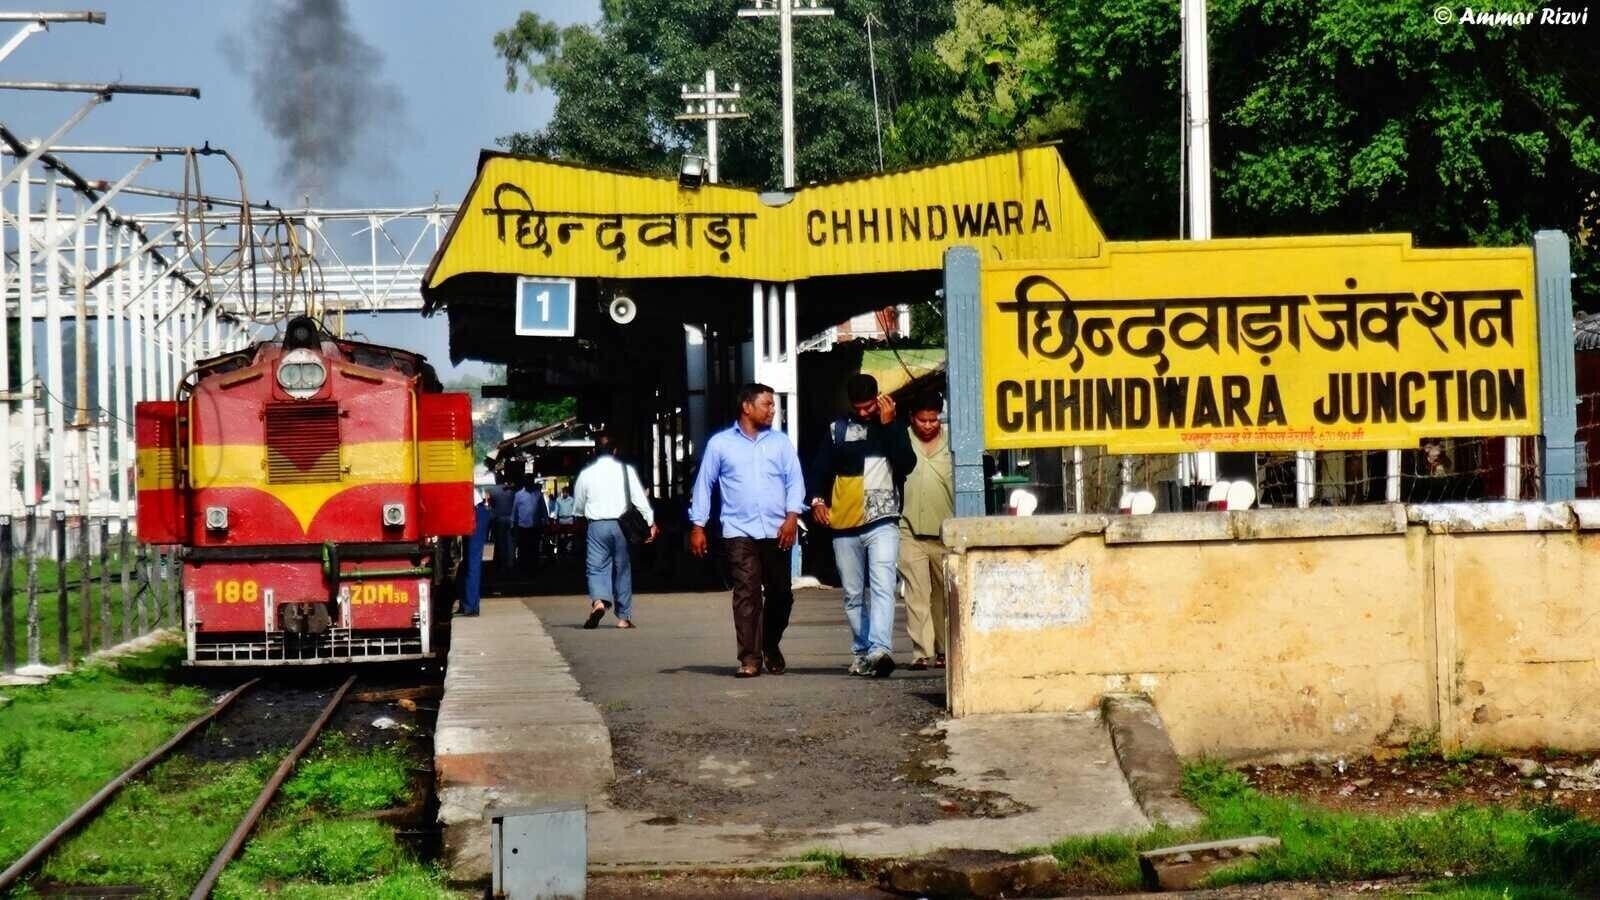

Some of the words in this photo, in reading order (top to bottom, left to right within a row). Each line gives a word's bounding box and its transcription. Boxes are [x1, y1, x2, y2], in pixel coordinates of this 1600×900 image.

[806, 199, 1052, 247] CHHINDWARA
[536, 291, 549, 323] 1
[996, 374, 1288, 433] CHHINDWARA
[1313, 368, 1527, 425] JUNCTION
[214, 580, 258, 604] 188
